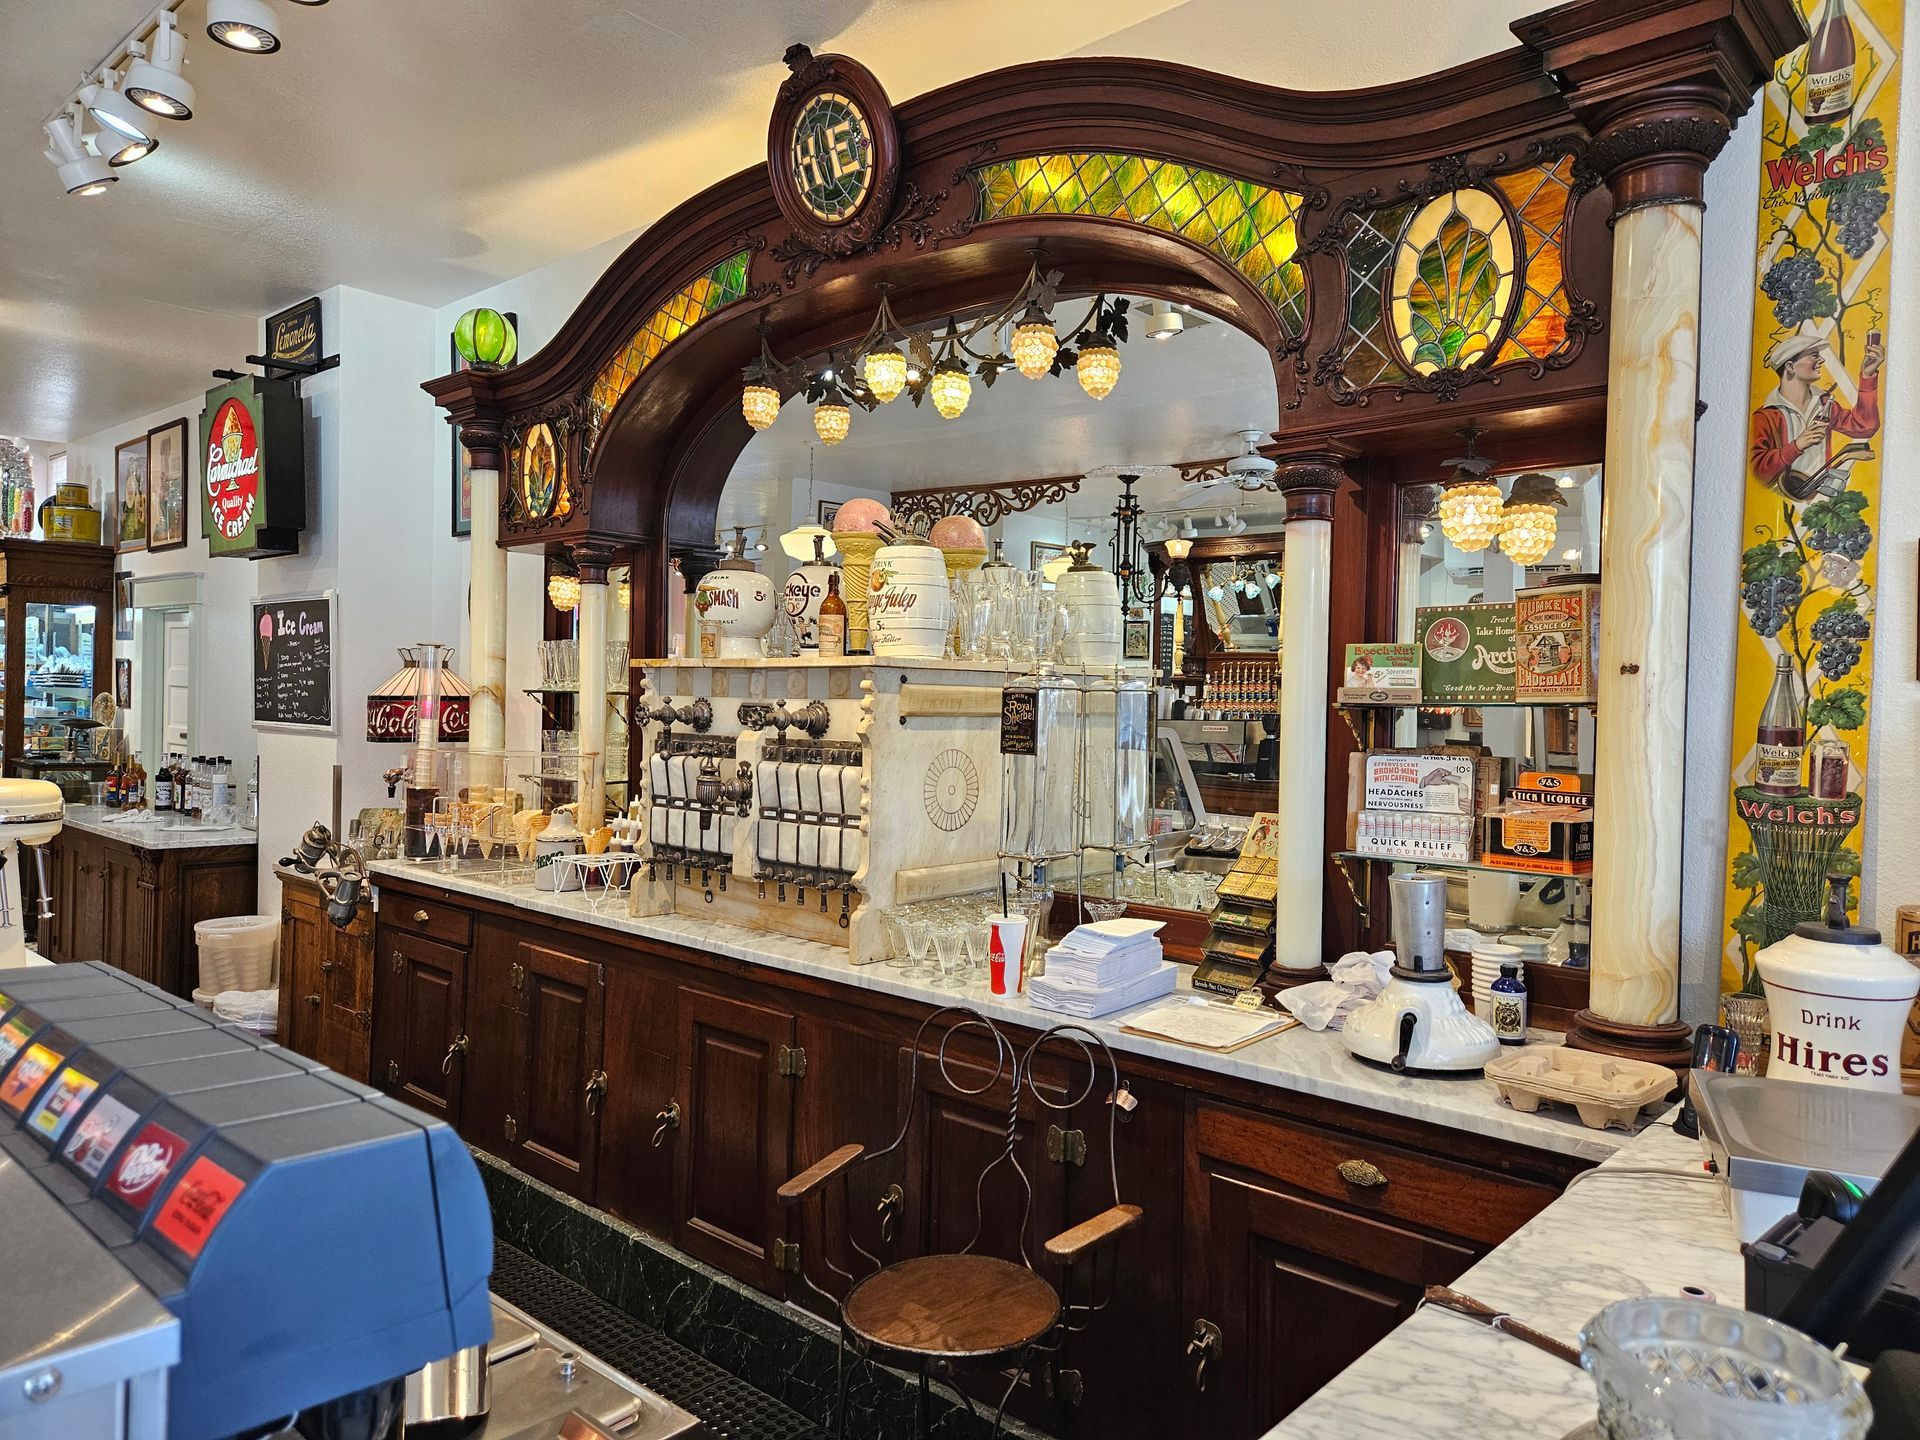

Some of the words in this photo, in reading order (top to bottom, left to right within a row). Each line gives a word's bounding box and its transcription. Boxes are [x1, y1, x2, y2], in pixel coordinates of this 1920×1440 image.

[1811, 71, 1850, 86] Welch's
[1765, 138, 1889, 192] Welch's
[272, 314, 316, 359] Lemonella
[207, 443, 258, 497] Carmichael
[222, 495, 243, 513] Quality
[211, 500, 225, 531] ICE
[226, 493, 255, 538] CREAM
[873, 560, 893, 569] DRINK
[708, 588, 739, 610] SMASH
[880, 586, 917, 613] Julep
[1519, 597, 1581, 622] RUNKEL'S
[277, 610, 296, 636] Ice
[299, 611, 324, 636] Cream
[1490, 616, 1508, 624] Treat
[1524, 622, 1559, 631] ESSENCE
[1561, 621, 1572, 629] OF
[1475, 627, 1493, 636] Take
[1354, 646, 1416, 655] Beech-Nut
[1471, 644, 1516, 671] Arcti
[1386, 656, 1414, 664] Chewing
[1518, 662, 1581, 687] CHOCOLATE
[1006, 697, 1033, 714] Royal
[1761, 746, 1800, 758] Welch's
[1456, 765, 1471, 773] 10¢
[1759, 759, 1781, 768] Grape
[1373, 775, 1390, 783] WITH
[1390, 775, 1419, 784] CAFFEINE
[1368, 788, 1423, 798] HEADACHES
[1512, 790, 1538, 802] STICK
[1541, 793, 1588, 805] LICORICE
[1368, 800, 1424, 809] NERVOUSNESS
[1740, 799, 1856, 825] Welch's
[1751, 822, 1768, 832] The
[1770, 825, 1814, 835] National
[1816, 828, 1845, 836] Drink
[1371, 837, 1407, 847] QUICK
[1414, 841, 1452, 850] RELIEF
[1386, 848, 1434, 857] MODERN
[1441, 851, 1465, 859] WAY
[1194, 980, 1216, 990] Beech-Nut
[1217, 985, 1236, 996] Chewing
[1801, 1008, 1861, 1031] Drink
[1777, 1032, 1889, 1077] Hires
[1810, 1070, 1825, 1078] TRADE
